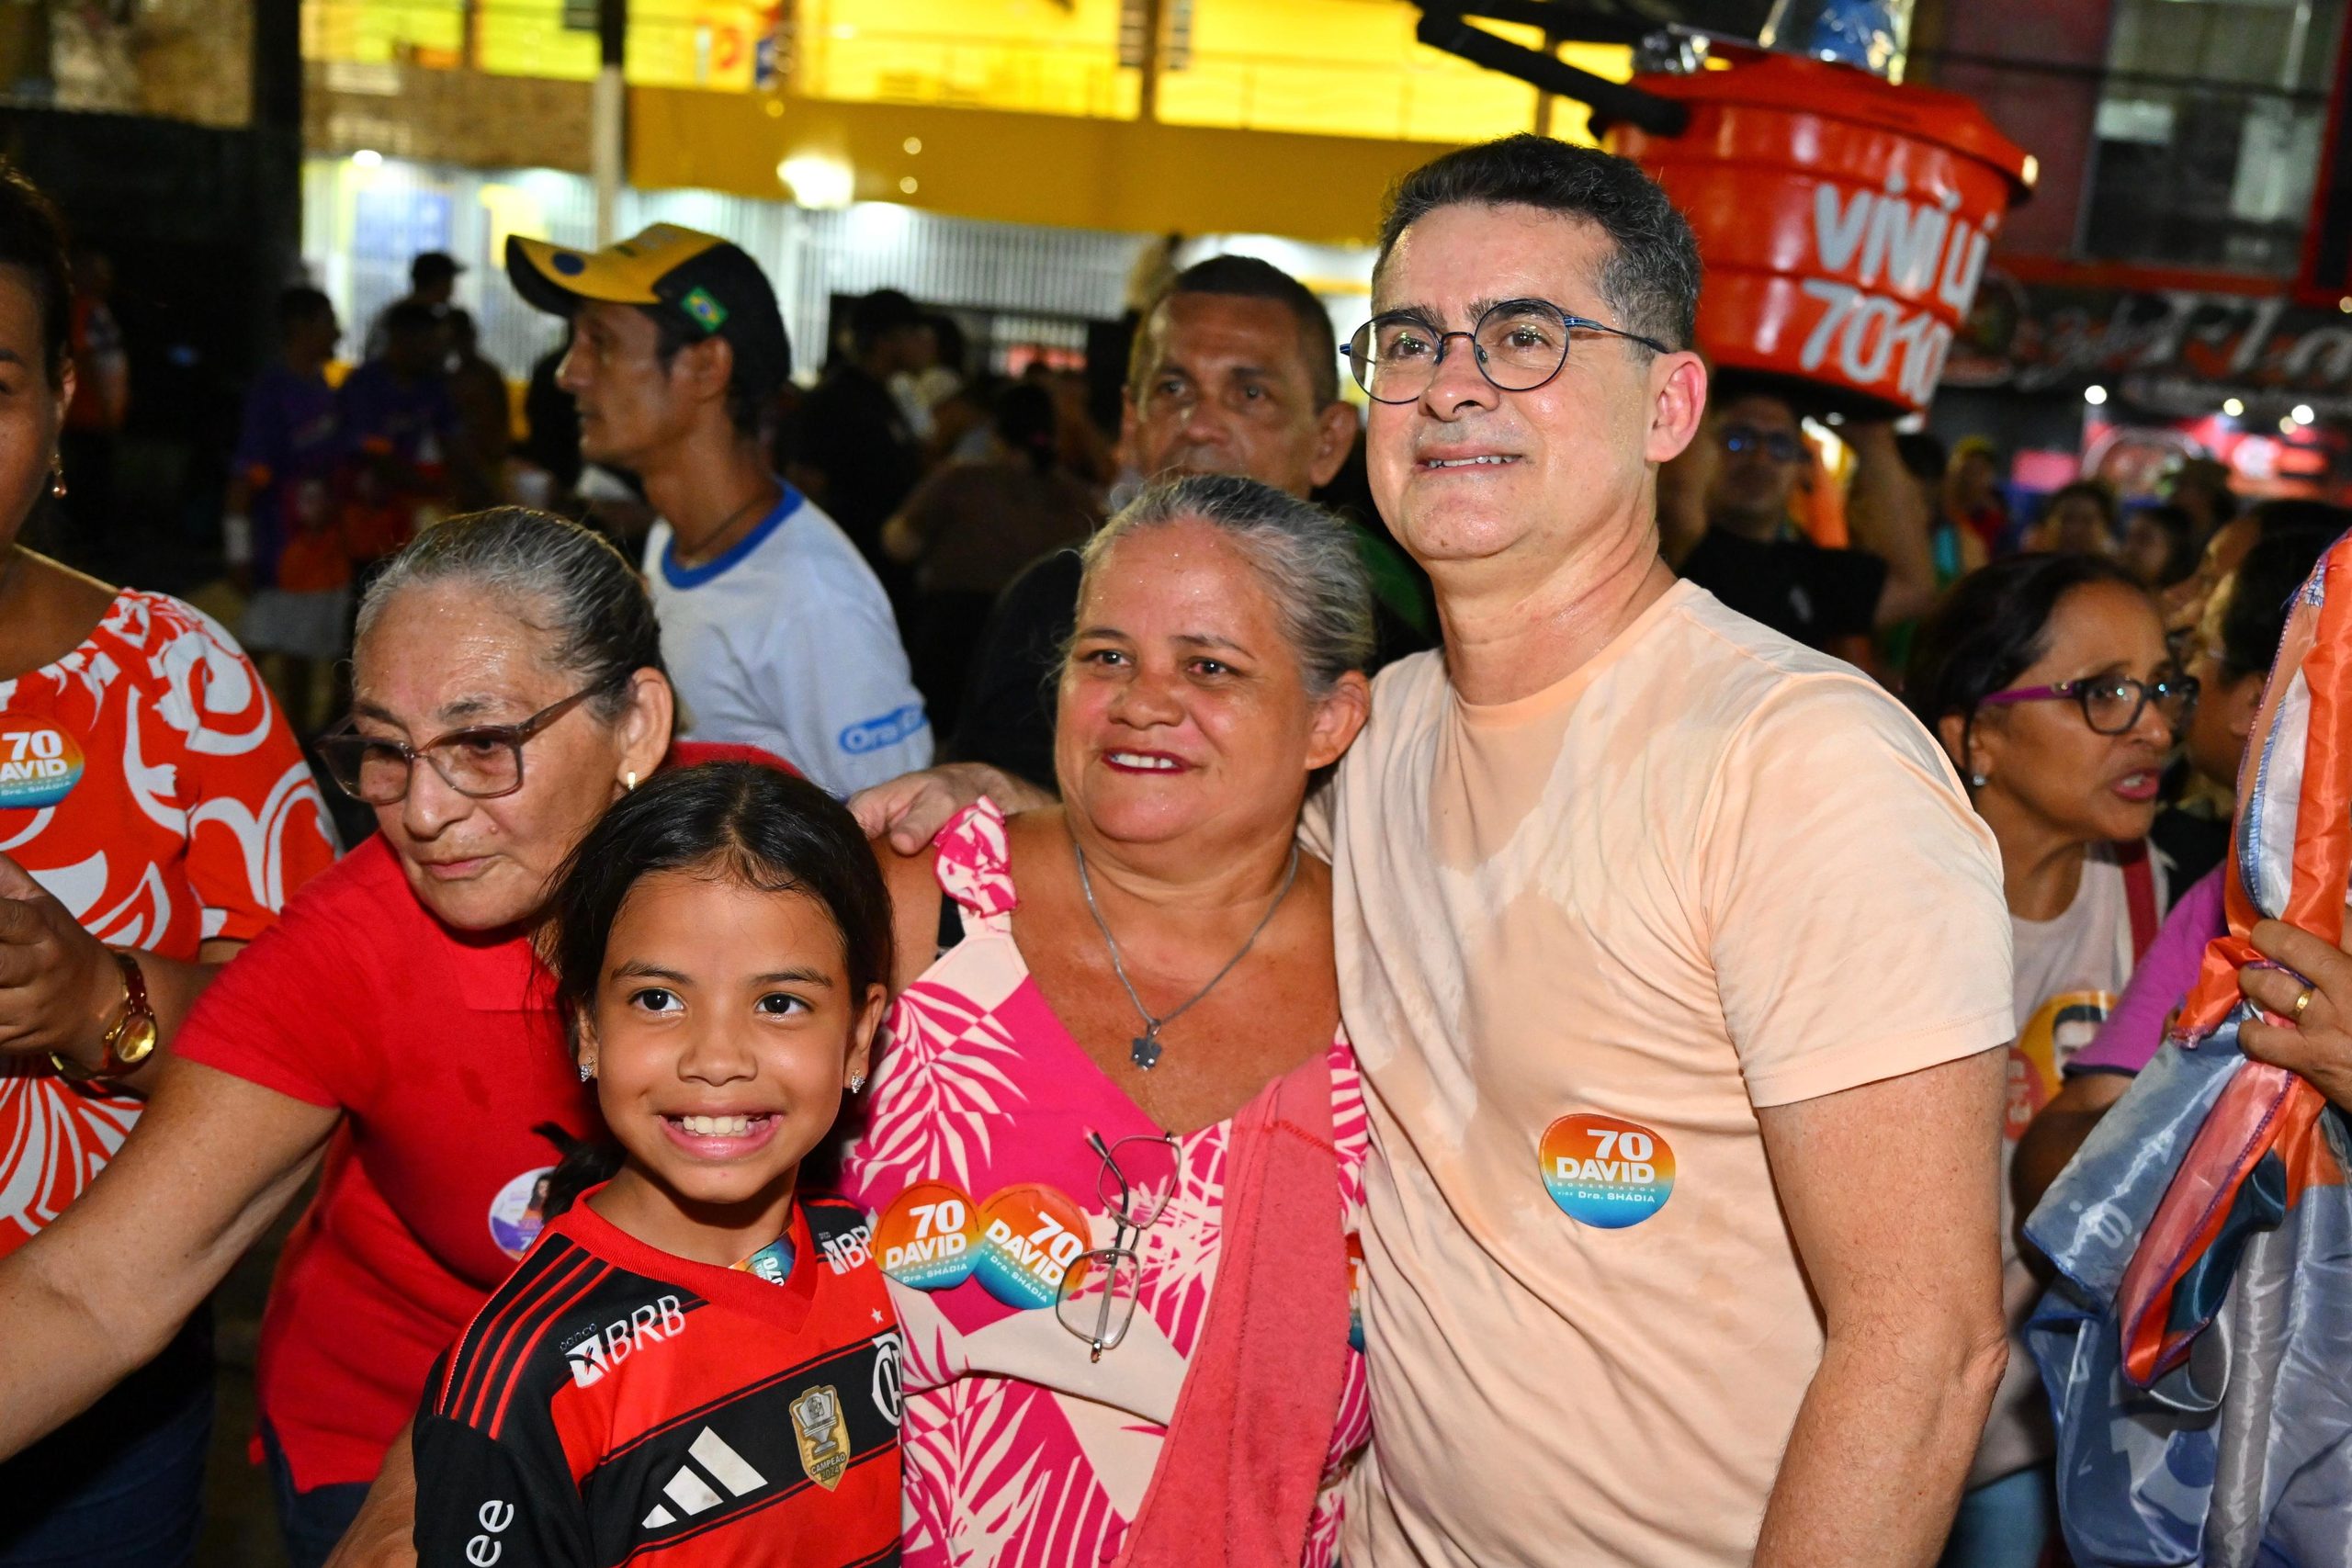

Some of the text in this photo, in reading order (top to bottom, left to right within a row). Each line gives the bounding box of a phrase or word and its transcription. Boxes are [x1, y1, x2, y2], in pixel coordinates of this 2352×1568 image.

[2, 729, 63, 761] 70
[1587, 1129, 1655, 1161] 70
[1556, 1156, 1656, 1184] DAVID
[909, 1199, 966, 1239] 70
[886, 1232, 967, 1270] DAVID
[985, 1218, 1066, 1287] DAVID
[1028, 1210, 1084, 1268] 70
[605, 1294, 686, 1366] BRB
